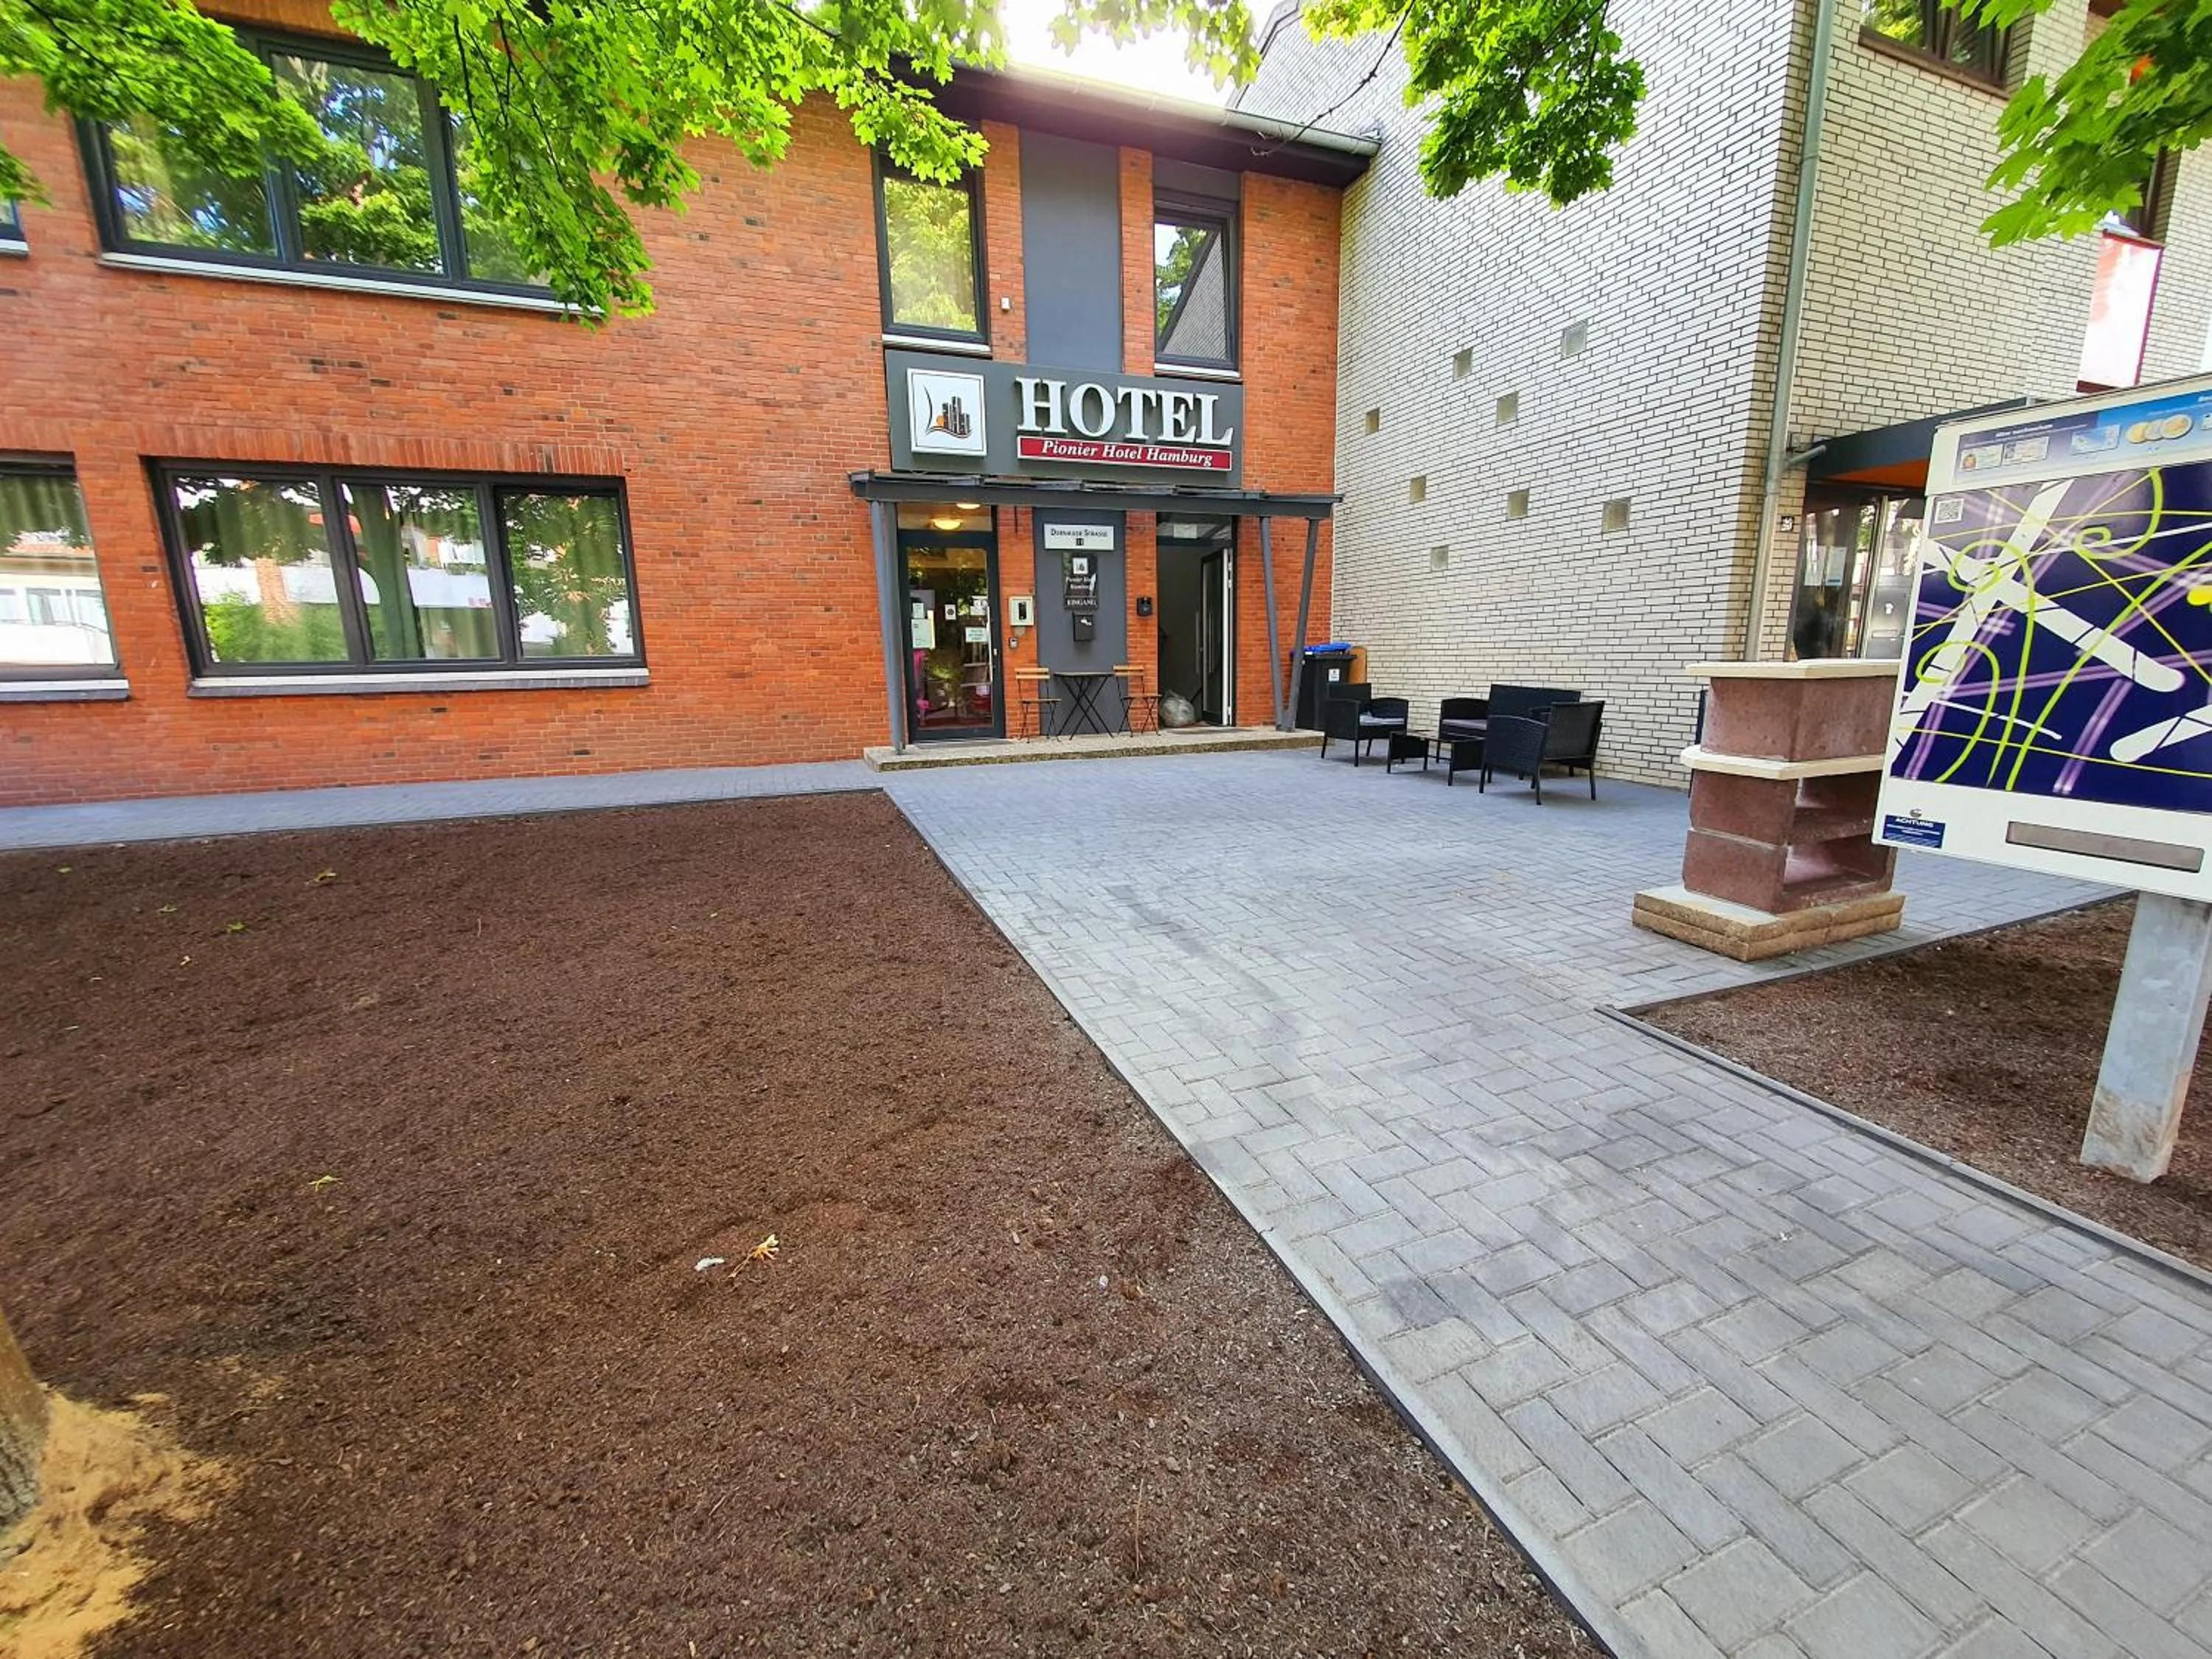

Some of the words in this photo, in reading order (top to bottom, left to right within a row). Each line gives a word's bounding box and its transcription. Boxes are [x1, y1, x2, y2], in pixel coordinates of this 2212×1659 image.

[1015, 377, 1234, 445] HOTEL
[1041, 439, 1098, 457] Pionier
[1102, 444, 1142, 460] Hotel
[1146, 449, 1213, 467] Hamburg
[1895, 818, 1934, 828] ACHTUNG
